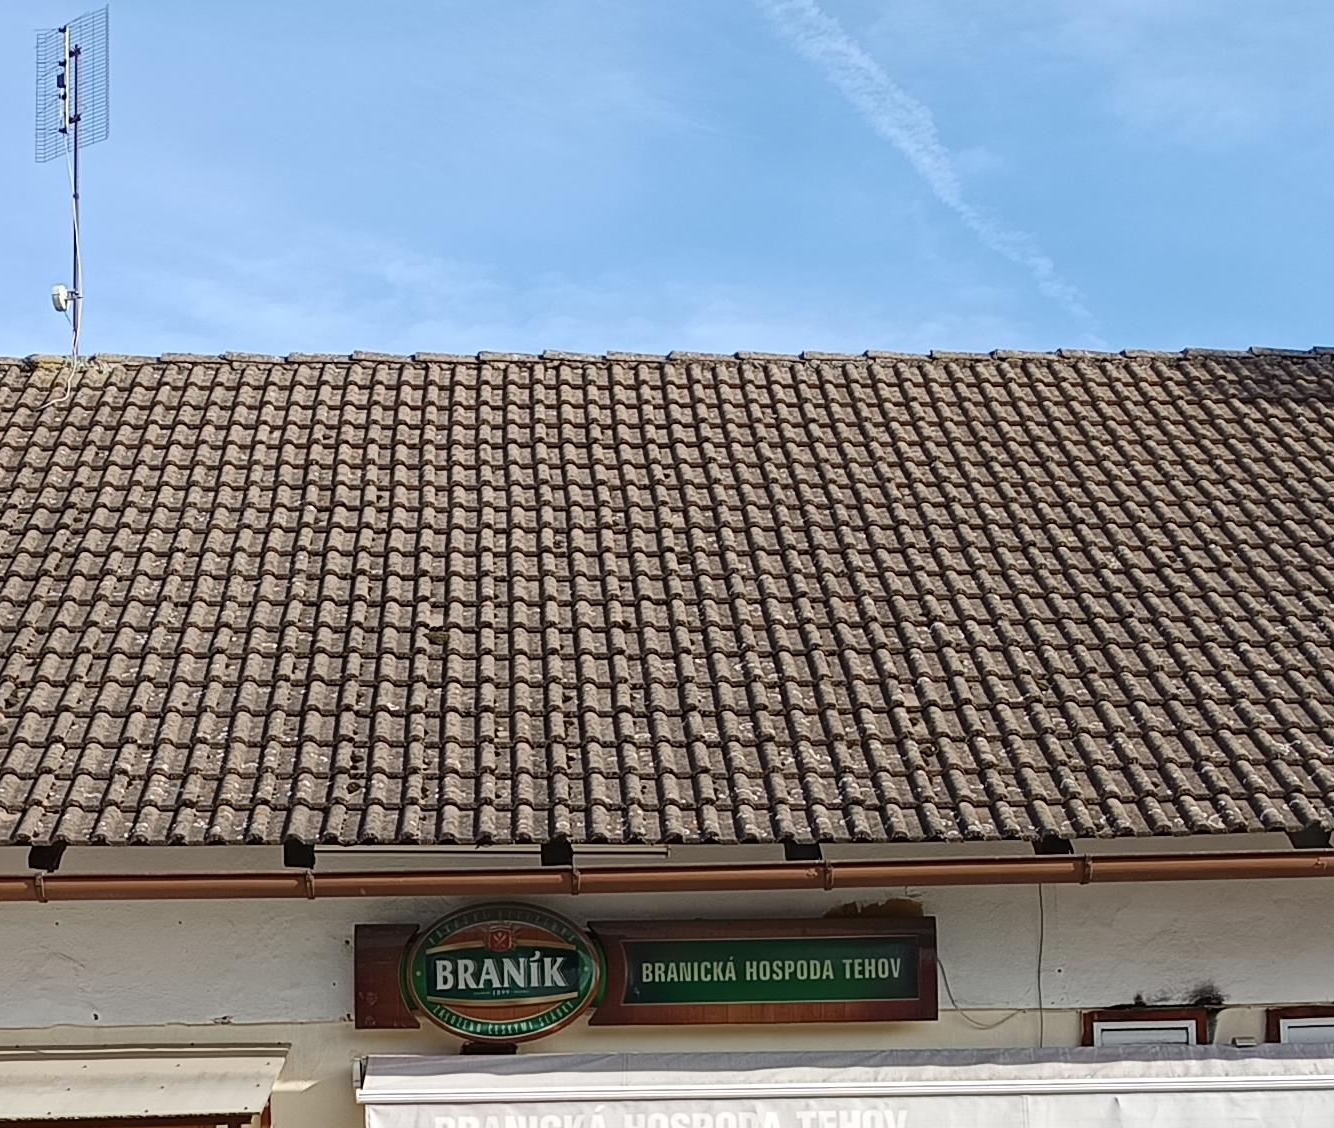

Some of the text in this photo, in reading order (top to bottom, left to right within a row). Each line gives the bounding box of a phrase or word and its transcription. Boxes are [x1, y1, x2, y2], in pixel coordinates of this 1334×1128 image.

[435, 950, 569, 990] BRANÍK
[641, 956, 902, 983] BRANICKÁ HOSPODA TEHOV
